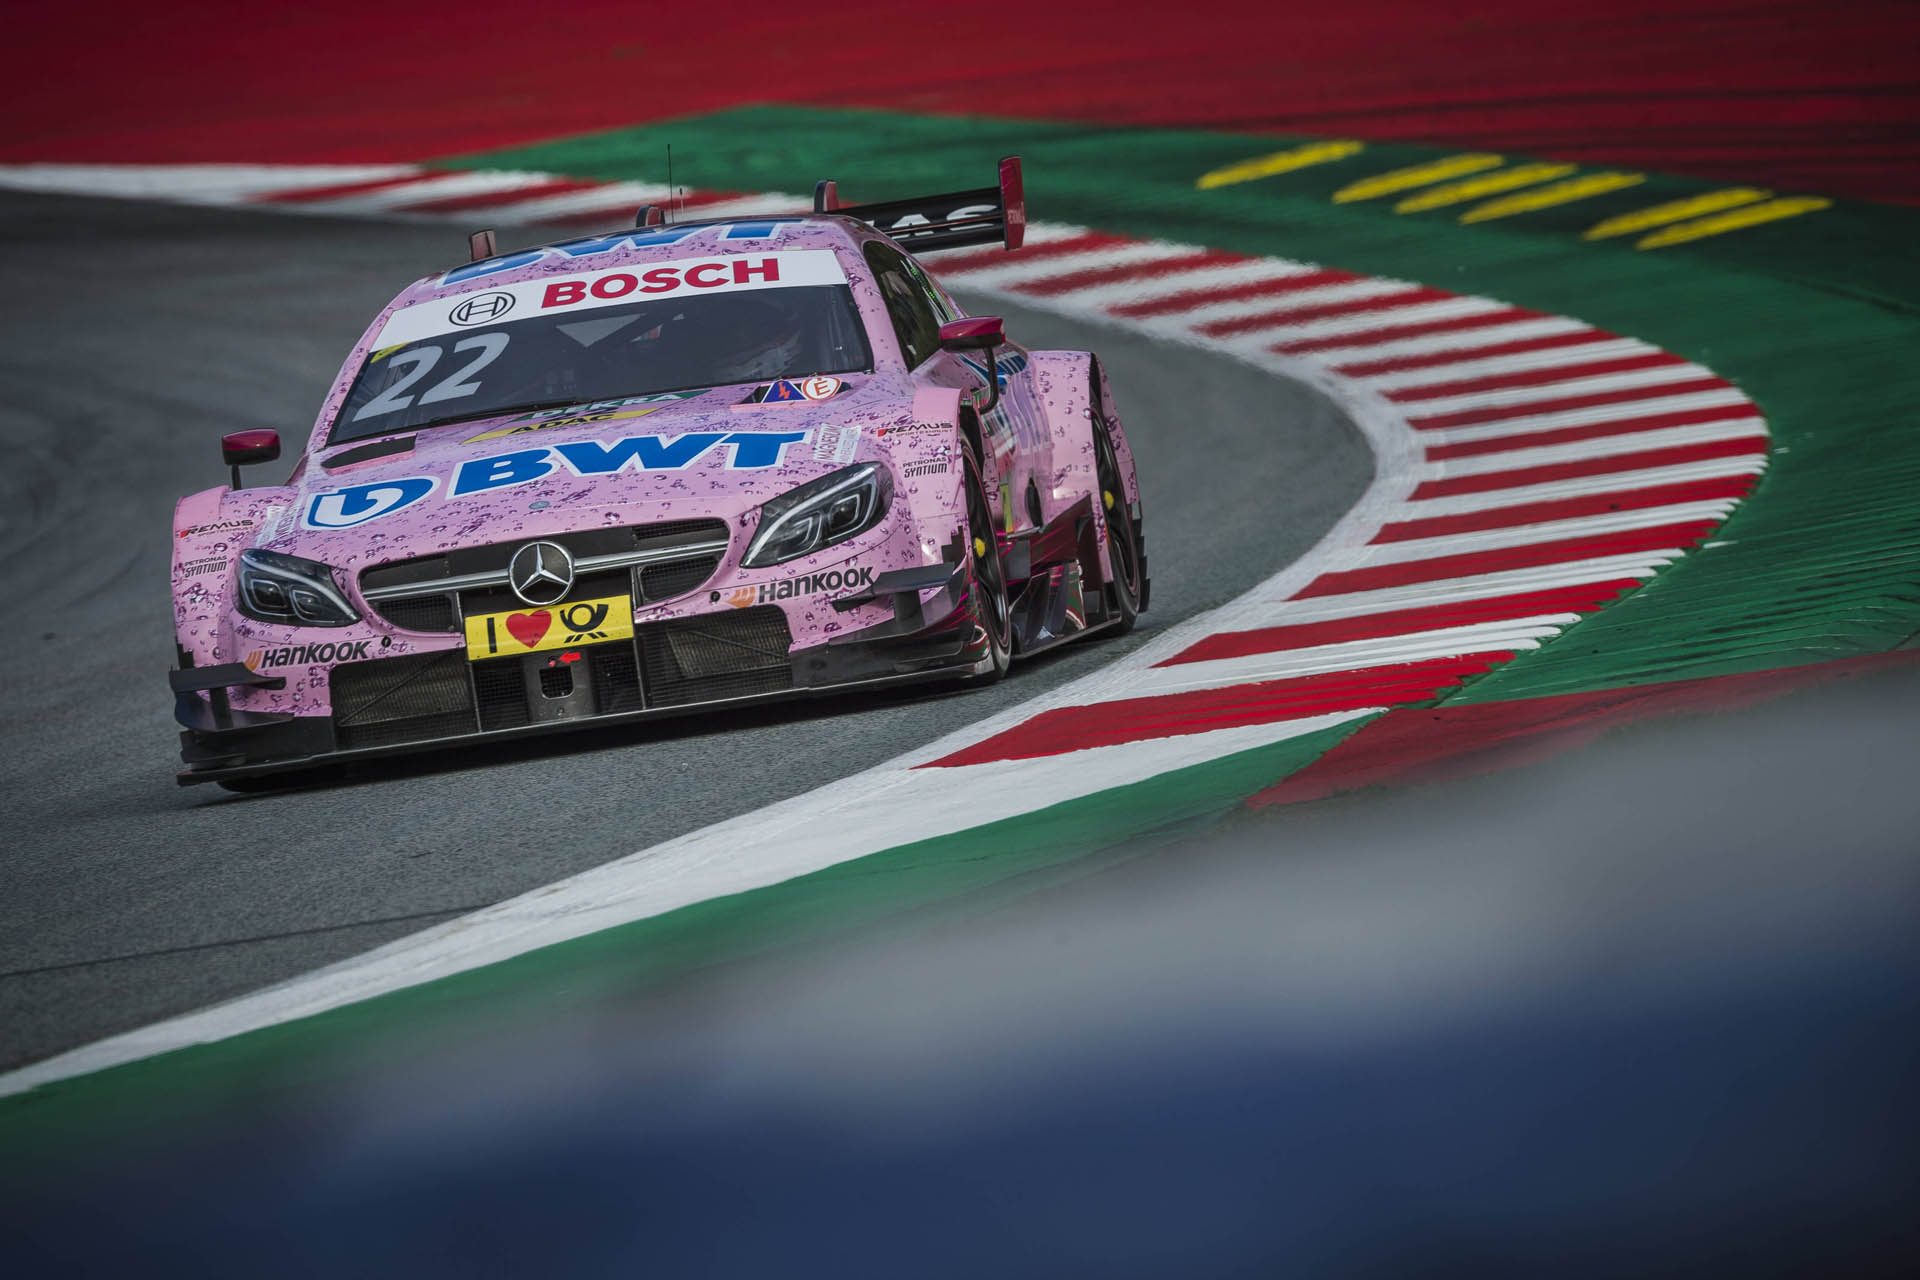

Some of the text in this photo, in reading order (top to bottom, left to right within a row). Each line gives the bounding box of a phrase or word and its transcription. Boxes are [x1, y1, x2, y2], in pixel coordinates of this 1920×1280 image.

[541, 258, 780, 309] BOSCH
[352, 332, 510, 422] 22
[531, 394, 682, 419] DEKRA
[508, 413, 617, 435] ADAC
[880, 422, 953, 436] REMUS
[453, 432, 806, 496] BWT
[902, 456, 947, 467] PETRONAS
[904, 463, 948, 478] SYNTIUM
[184, 519, 254, 537] REMUS
[184, 555, 228, 567] PETRONAS
[184, 561, 228, 578] SYNTIUM
[486, 617, 498, 654] I
